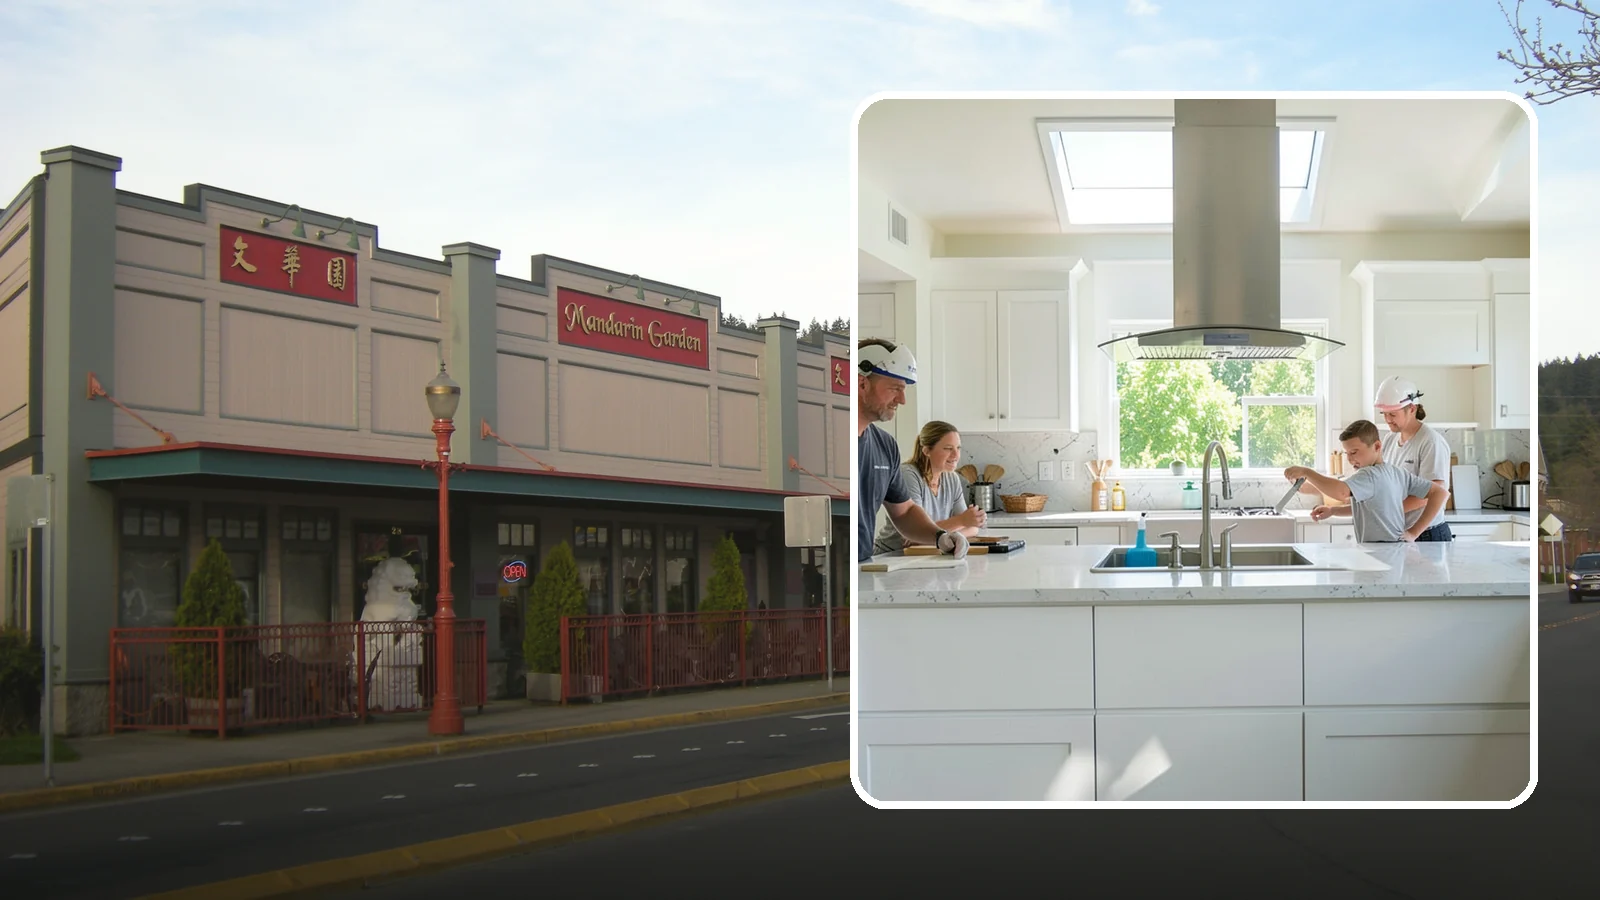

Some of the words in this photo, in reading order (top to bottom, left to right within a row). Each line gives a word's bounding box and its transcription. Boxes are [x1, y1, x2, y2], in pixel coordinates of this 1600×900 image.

[564, 302, 643, 341] Mandarin
[647, 320, 702, 352] Garden
[503, 565, 527, 578] OPEN
